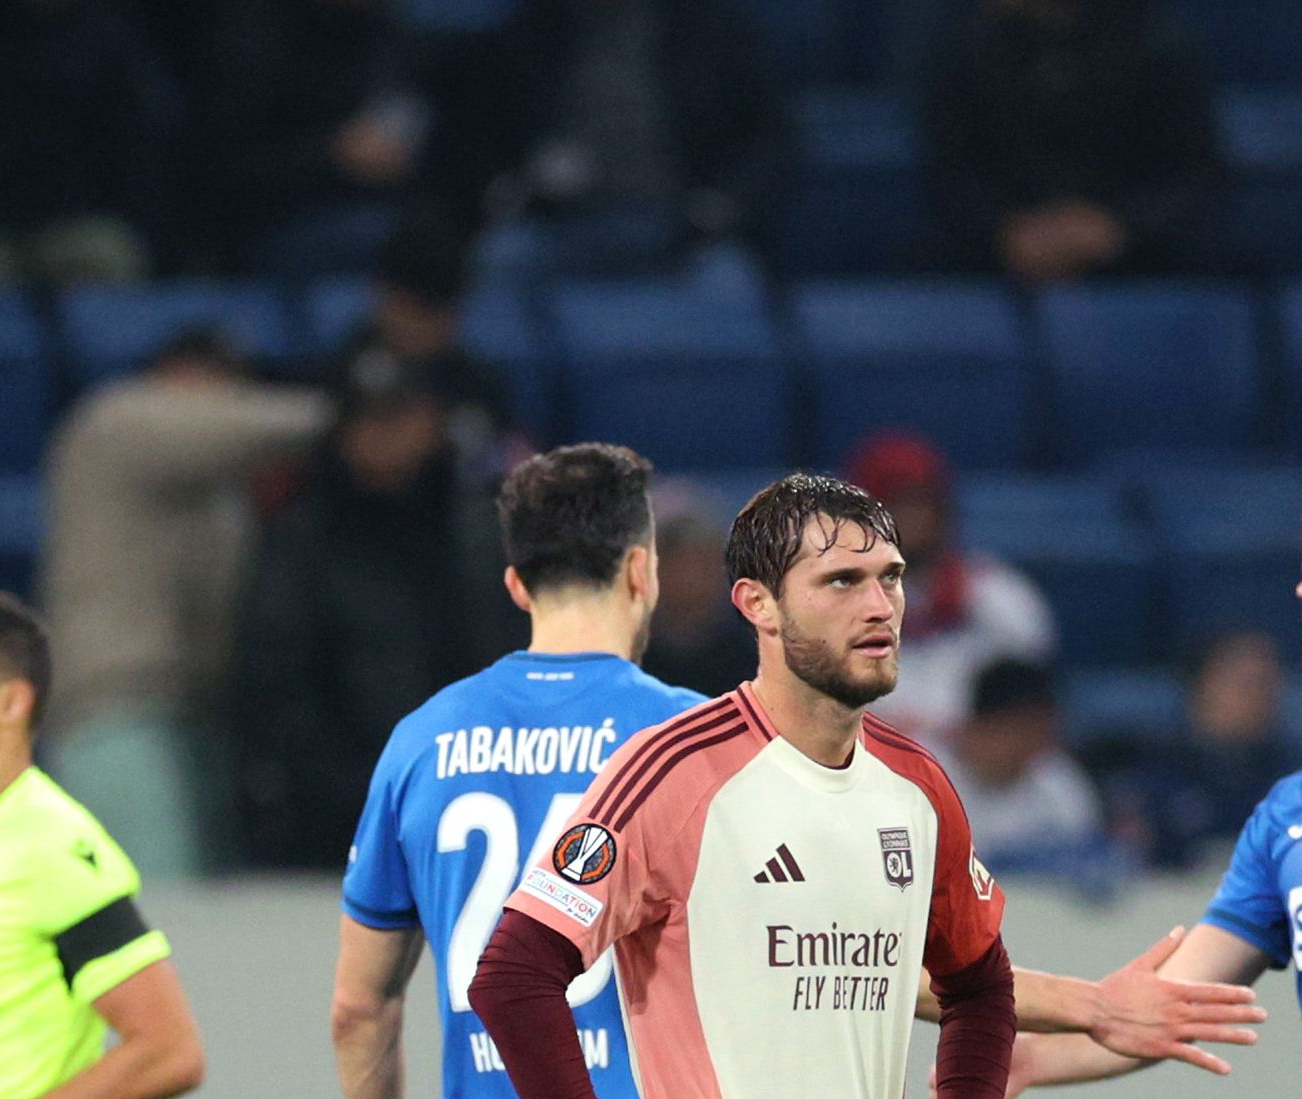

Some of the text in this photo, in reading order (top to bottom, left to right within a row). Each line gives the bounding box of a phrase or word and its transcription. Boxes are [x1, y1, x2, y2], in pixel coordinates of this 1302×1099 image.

[435, 717, 617, 780] TABAKOVIĆ
[887, 851, 912, 879] OL
[765, 921, 903, 968] Emirate
[792, 975, 889, 1011] FLY BETTER
